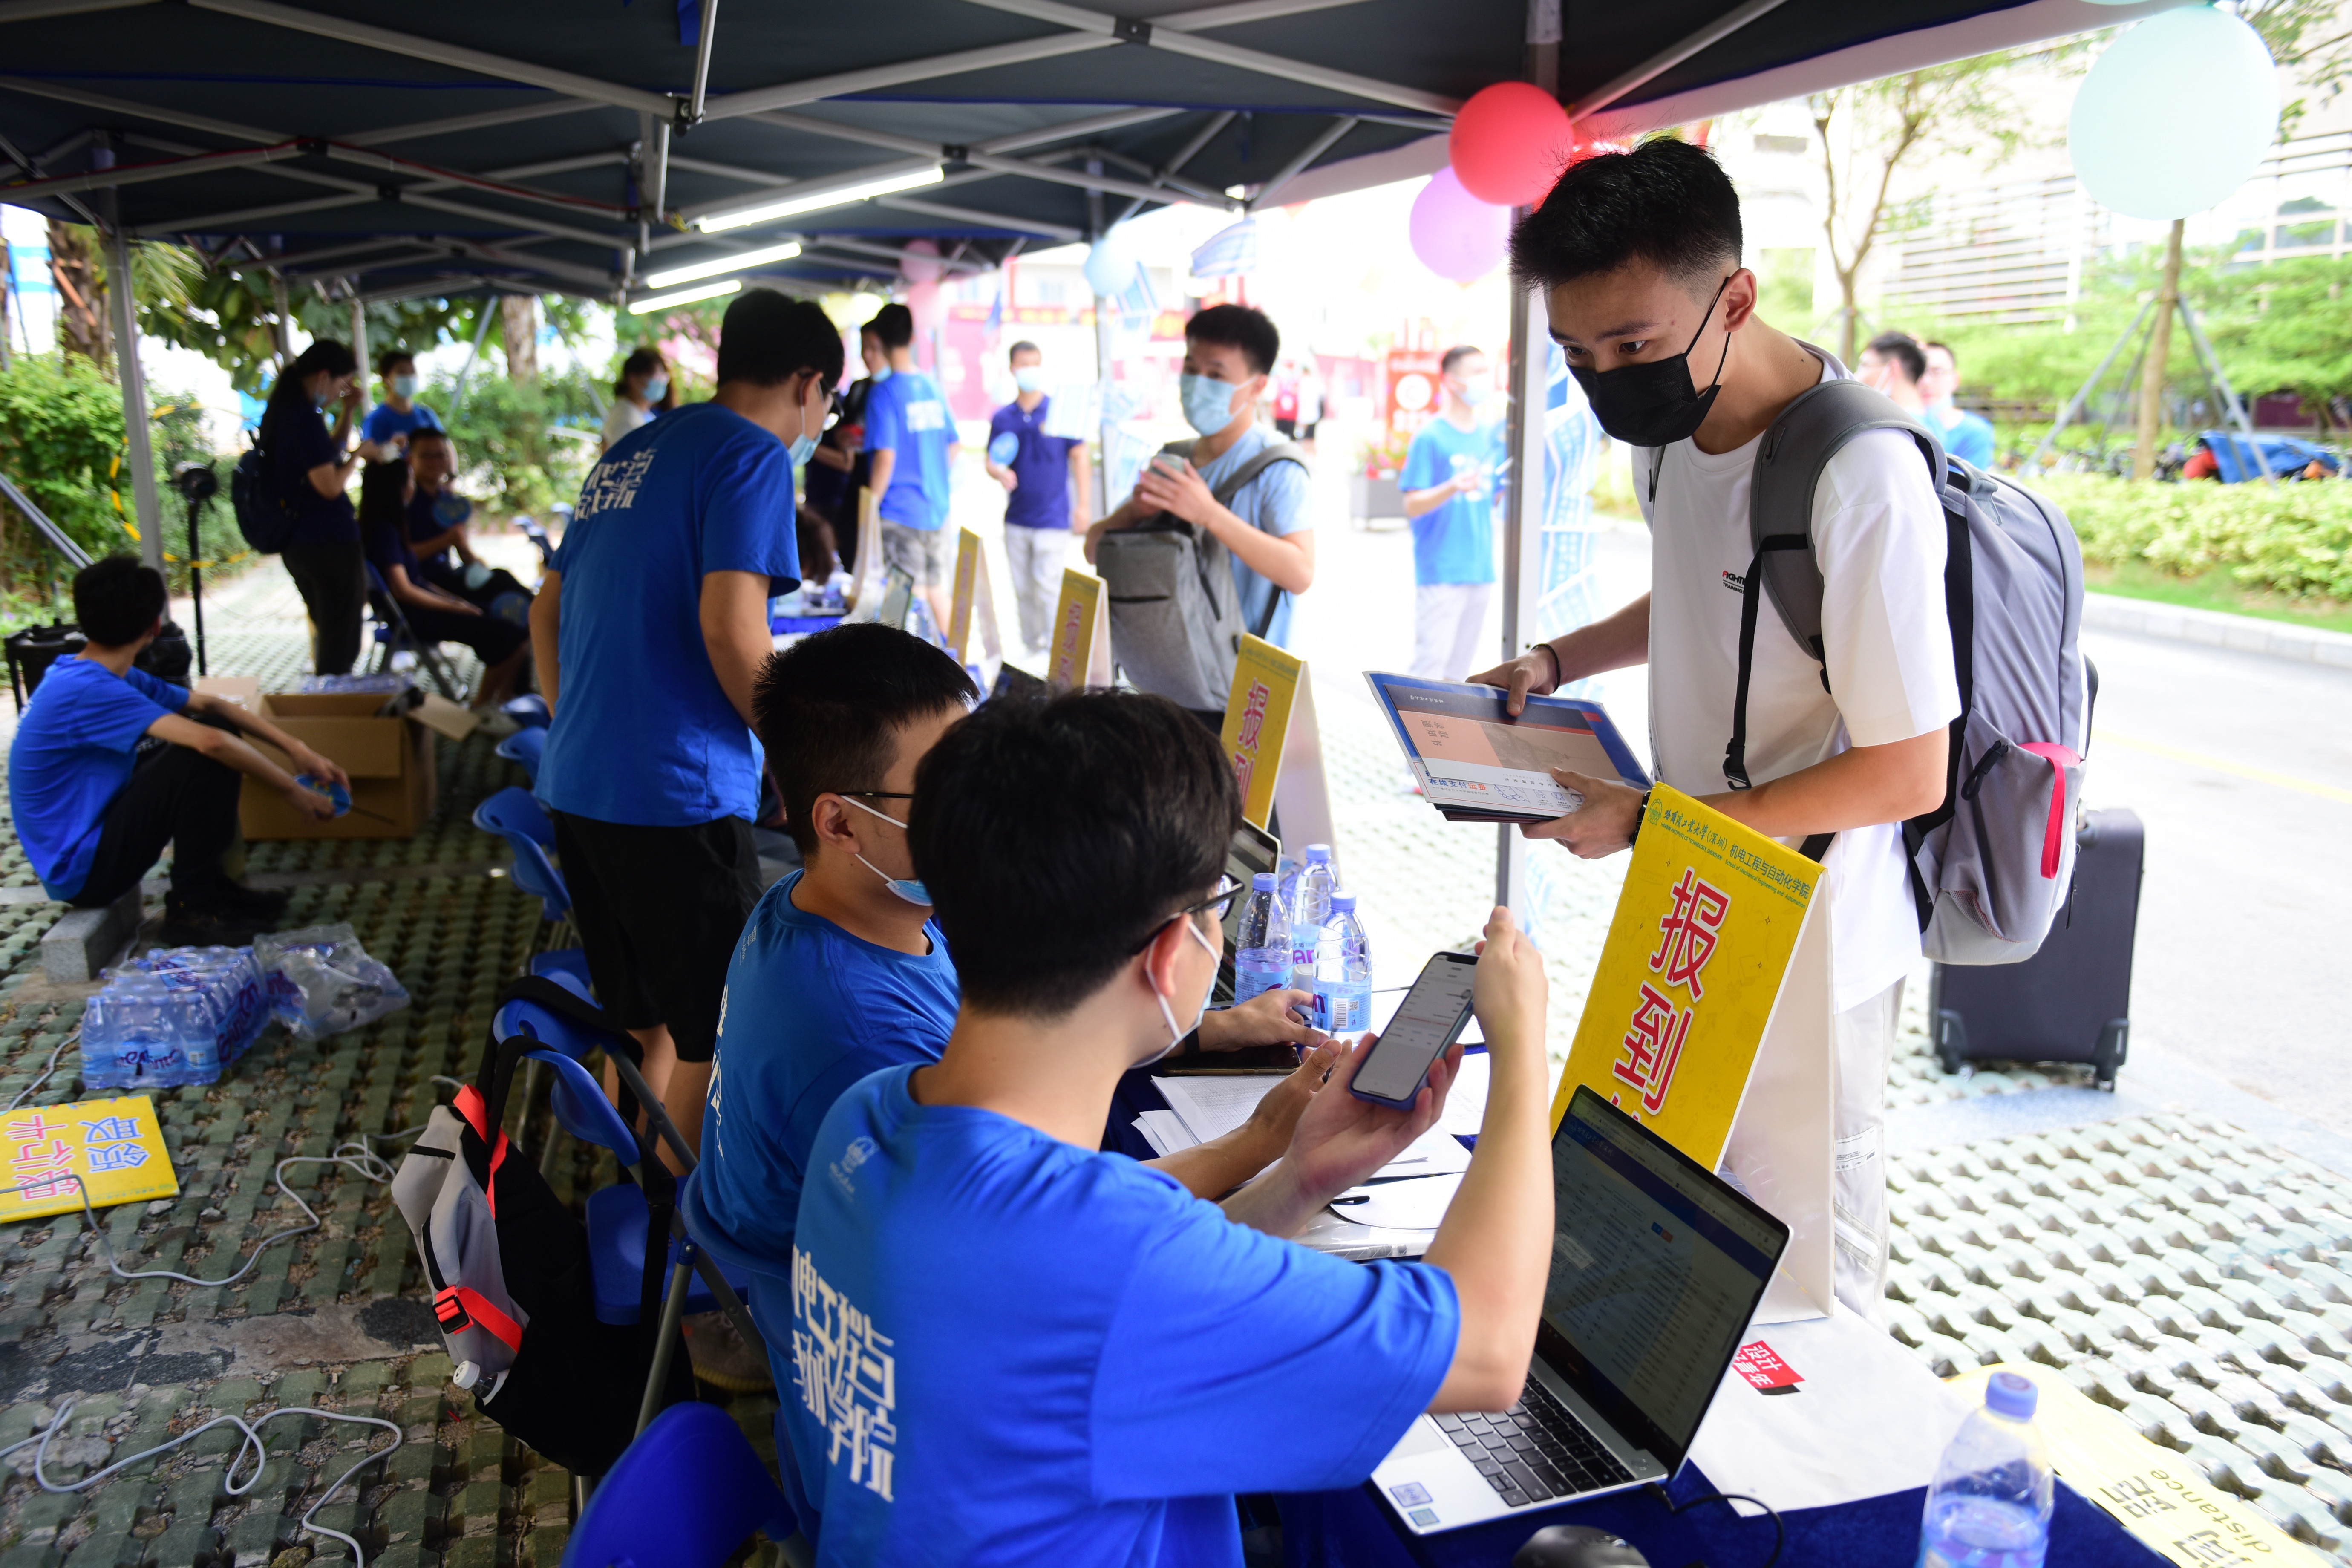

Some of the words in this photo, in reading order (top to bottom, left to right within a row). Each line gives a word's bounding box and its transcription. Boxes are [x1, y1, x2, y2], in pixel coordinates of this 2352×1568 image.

[1723, 582, 1742, 594] TRAINING
[1428, 778, 1487, 791] 在线支付运费
[1661, 822, 1671, 831] HARBIN
[1671, 827, 1684, 839] INSTITUTE
[1688, 837, 1707, 852] TECHNOLOGY,
[1706, 848, 1723, 860] SHENZHEN
[1725, 859, 1735, 868] School
[1740, 867, 1757, 881] Mechanical
[1757, 878, 1777, 894] Engineering
[1784, 894, 1806, 909] Automation
[1729, 843, 1810, 899] 机电工程与自动化学院
[5, 1114, 81, 1200] 银行卡
[78, 1115, 151, 1173] 领取
[1742, 1344, 1782, 1371] 设计
[2150, 1469, 2271, 1553] distance
